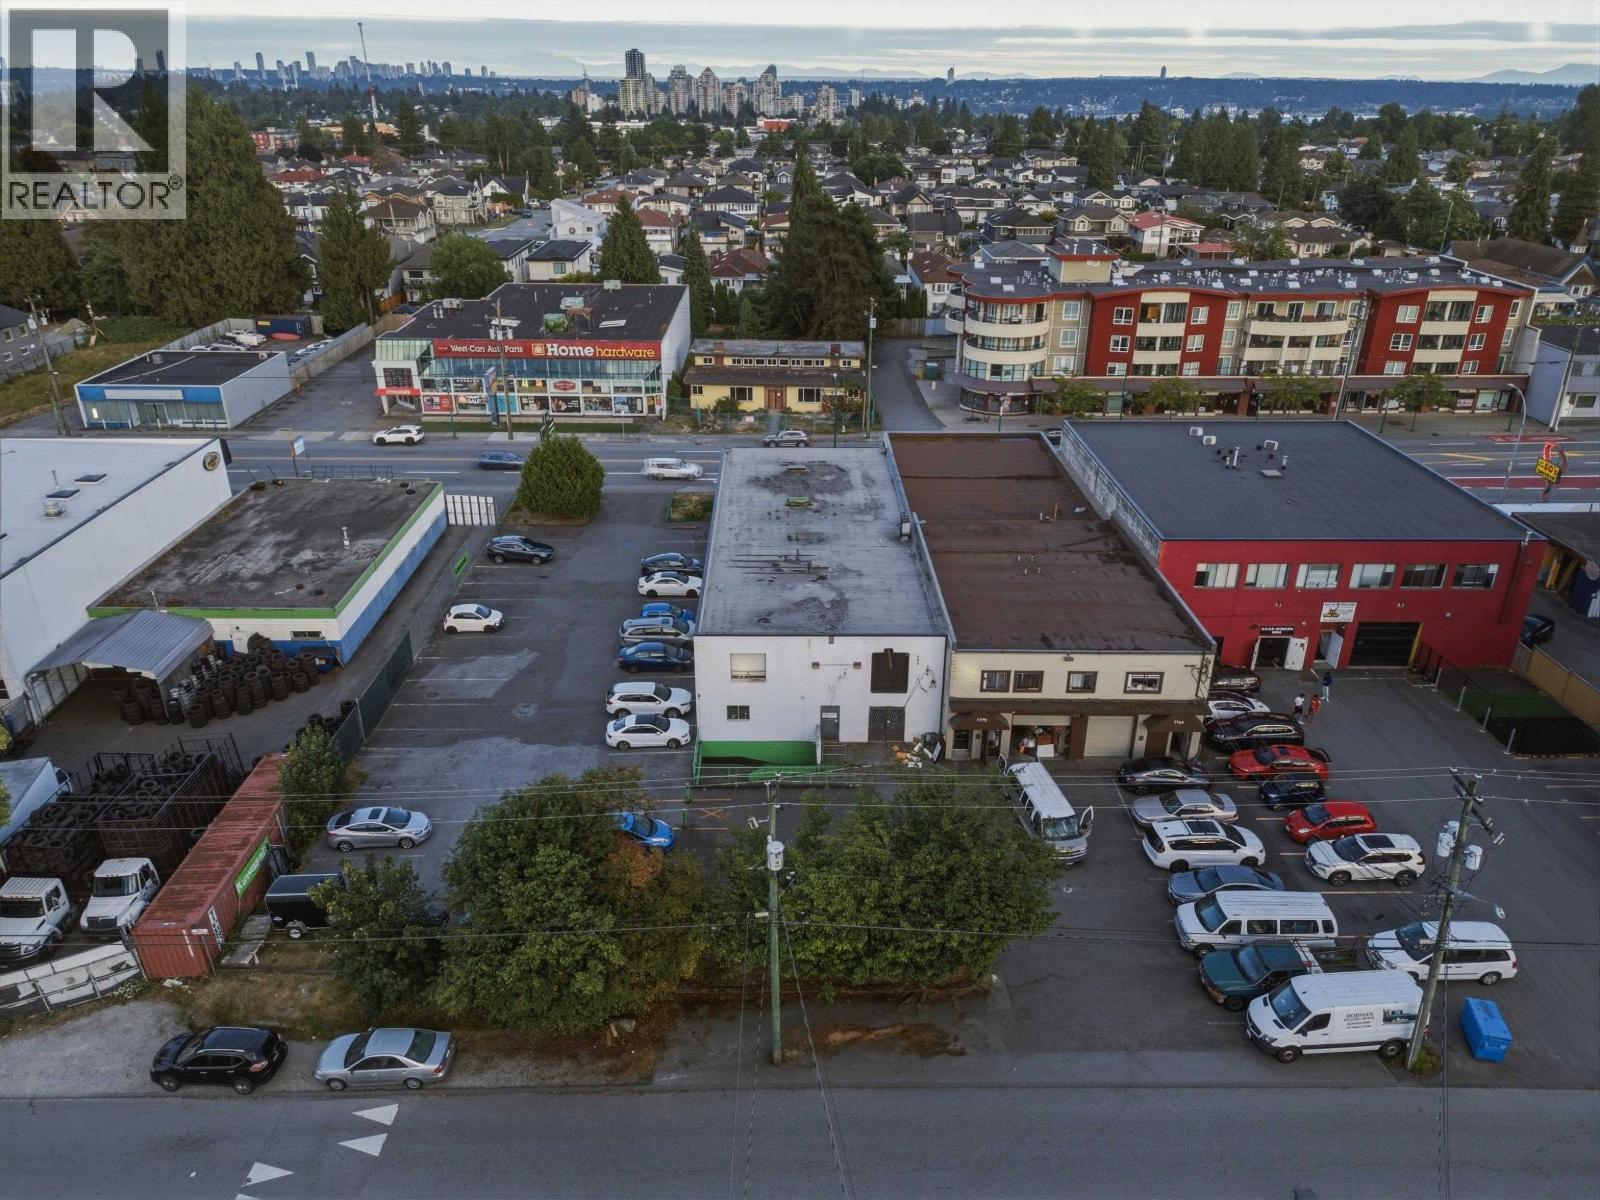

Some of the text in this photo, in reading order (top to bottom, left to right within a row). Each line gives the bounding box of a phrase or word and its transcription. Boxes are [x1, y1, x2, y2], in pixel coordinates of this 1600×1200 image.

[487, 344, 503, 353] Aut
[504, 344, 523, 353] Parts
[546, 343, 655, 357] Home hardware
